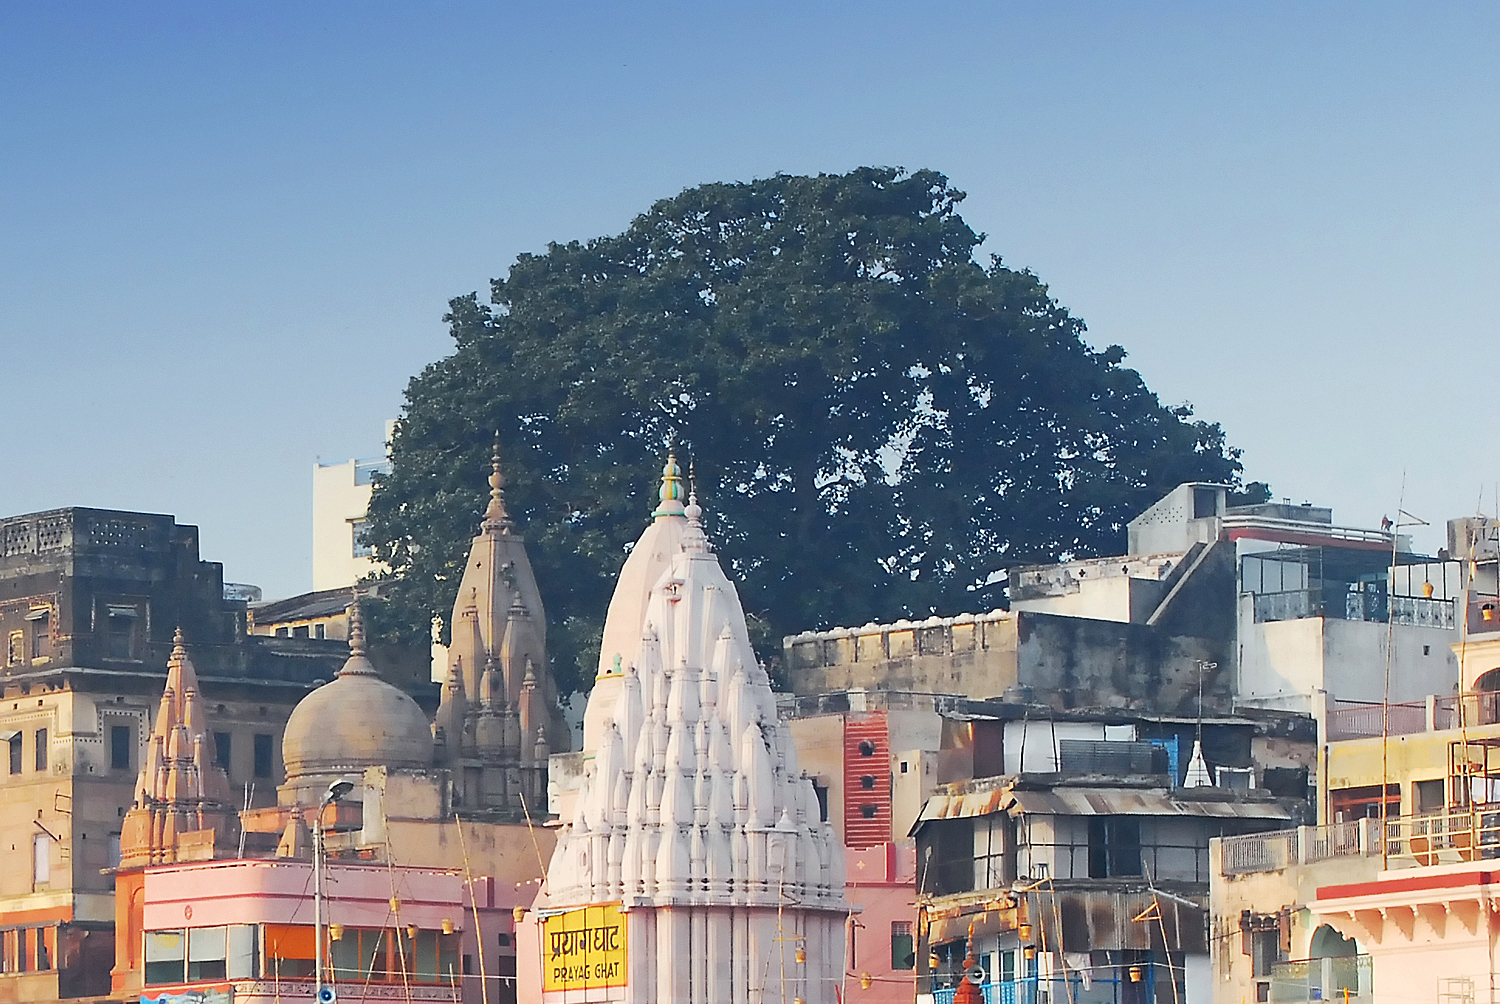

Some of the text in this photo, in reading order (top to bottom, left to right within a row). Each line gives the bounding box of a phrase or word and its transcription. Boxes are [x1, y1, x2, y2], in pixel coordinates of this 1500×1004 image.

[550, 925, 619, 962] प्रयाग घाट
[553, 961, 620, 983] PRAYAG GHAT
